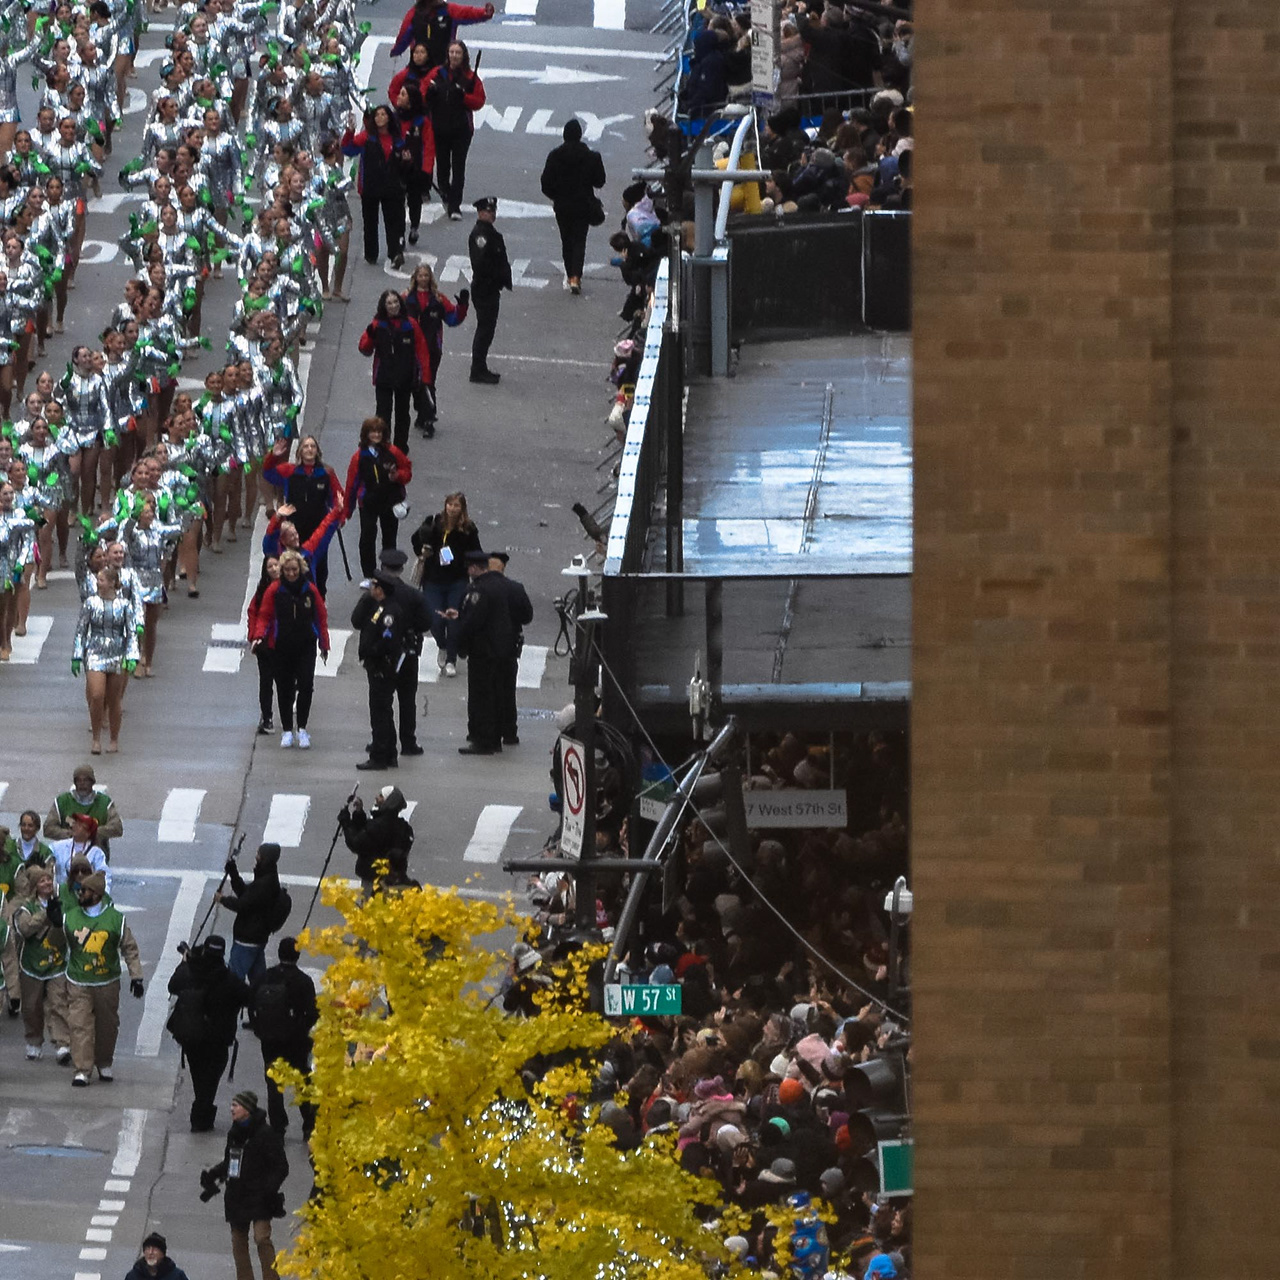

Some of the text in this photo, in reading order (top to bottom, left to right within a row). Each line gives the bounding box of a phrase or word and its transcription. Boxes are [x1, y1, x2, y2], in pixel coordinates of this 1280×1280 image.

[758, 803, 792, 816] West
[796, 803, 824, 815] 57th
[623, 987, 676, 1011] W 57 St
